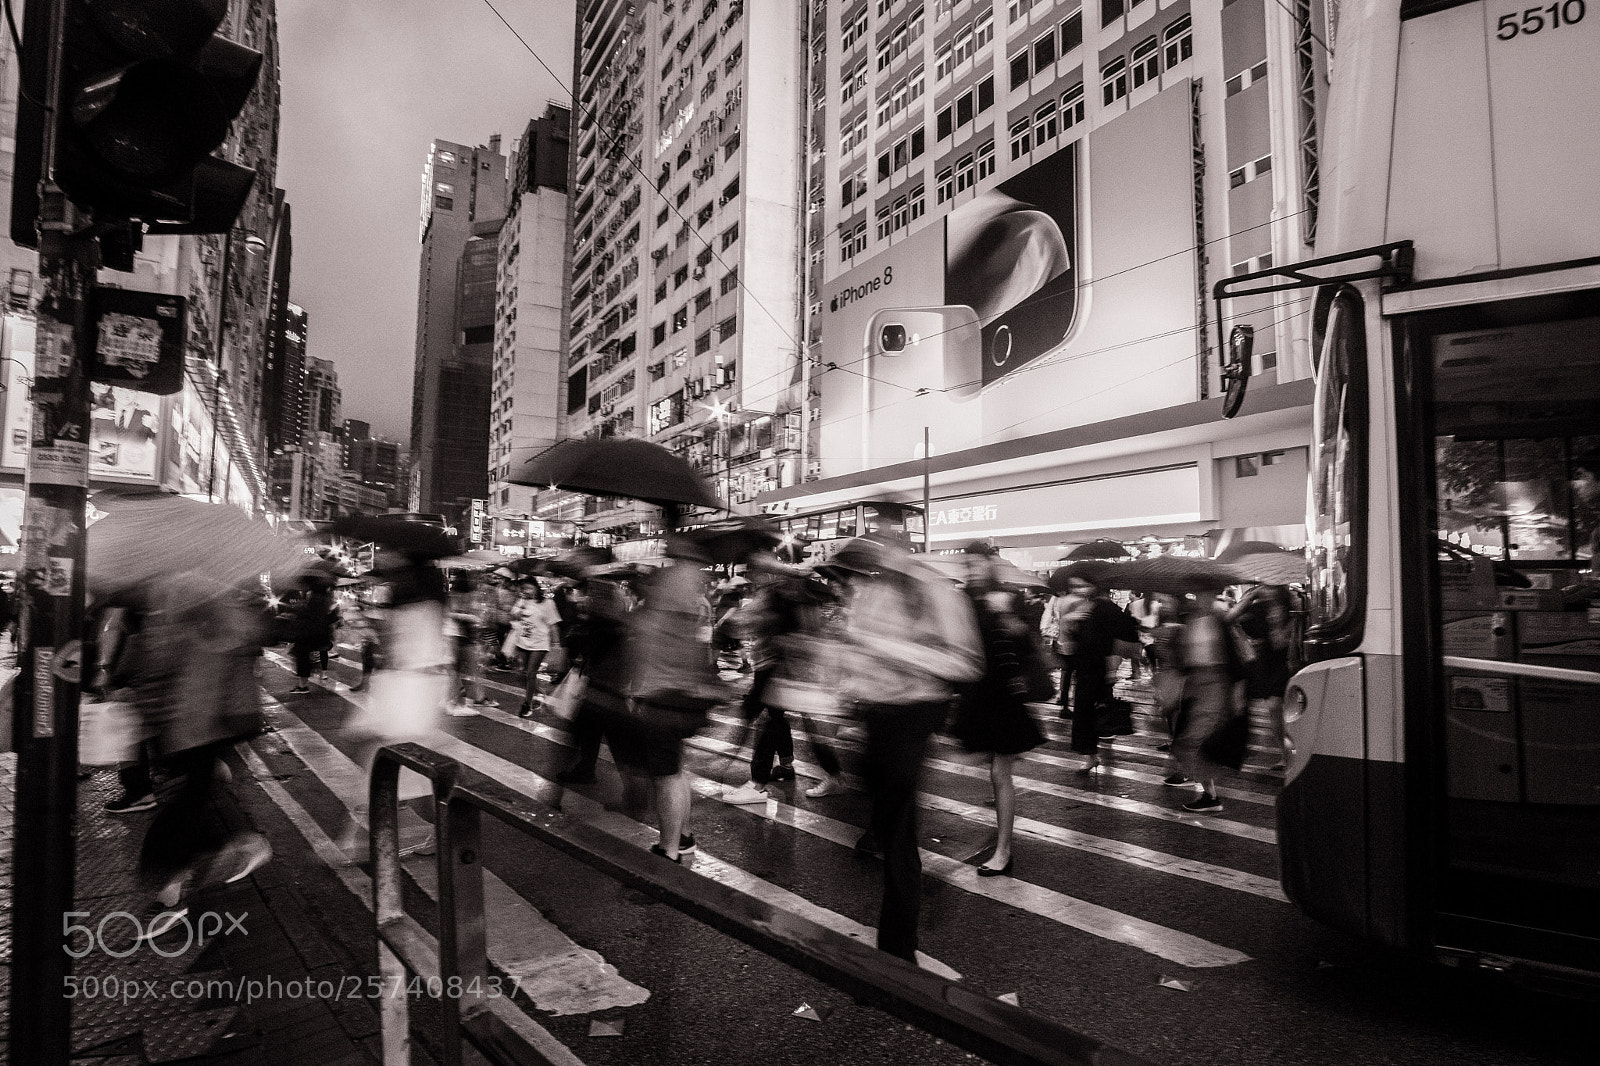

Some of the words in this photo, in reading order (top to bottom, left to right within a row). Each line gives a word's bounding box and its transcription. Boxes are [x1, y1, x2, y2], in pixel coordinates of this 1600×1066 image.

[1496, 0, 1586, 41] 5510
[839, 277, 881, 309] iPhone
[883, 266, 893, 286] 8
[948, 504, 998, 524] 東亞銀行
